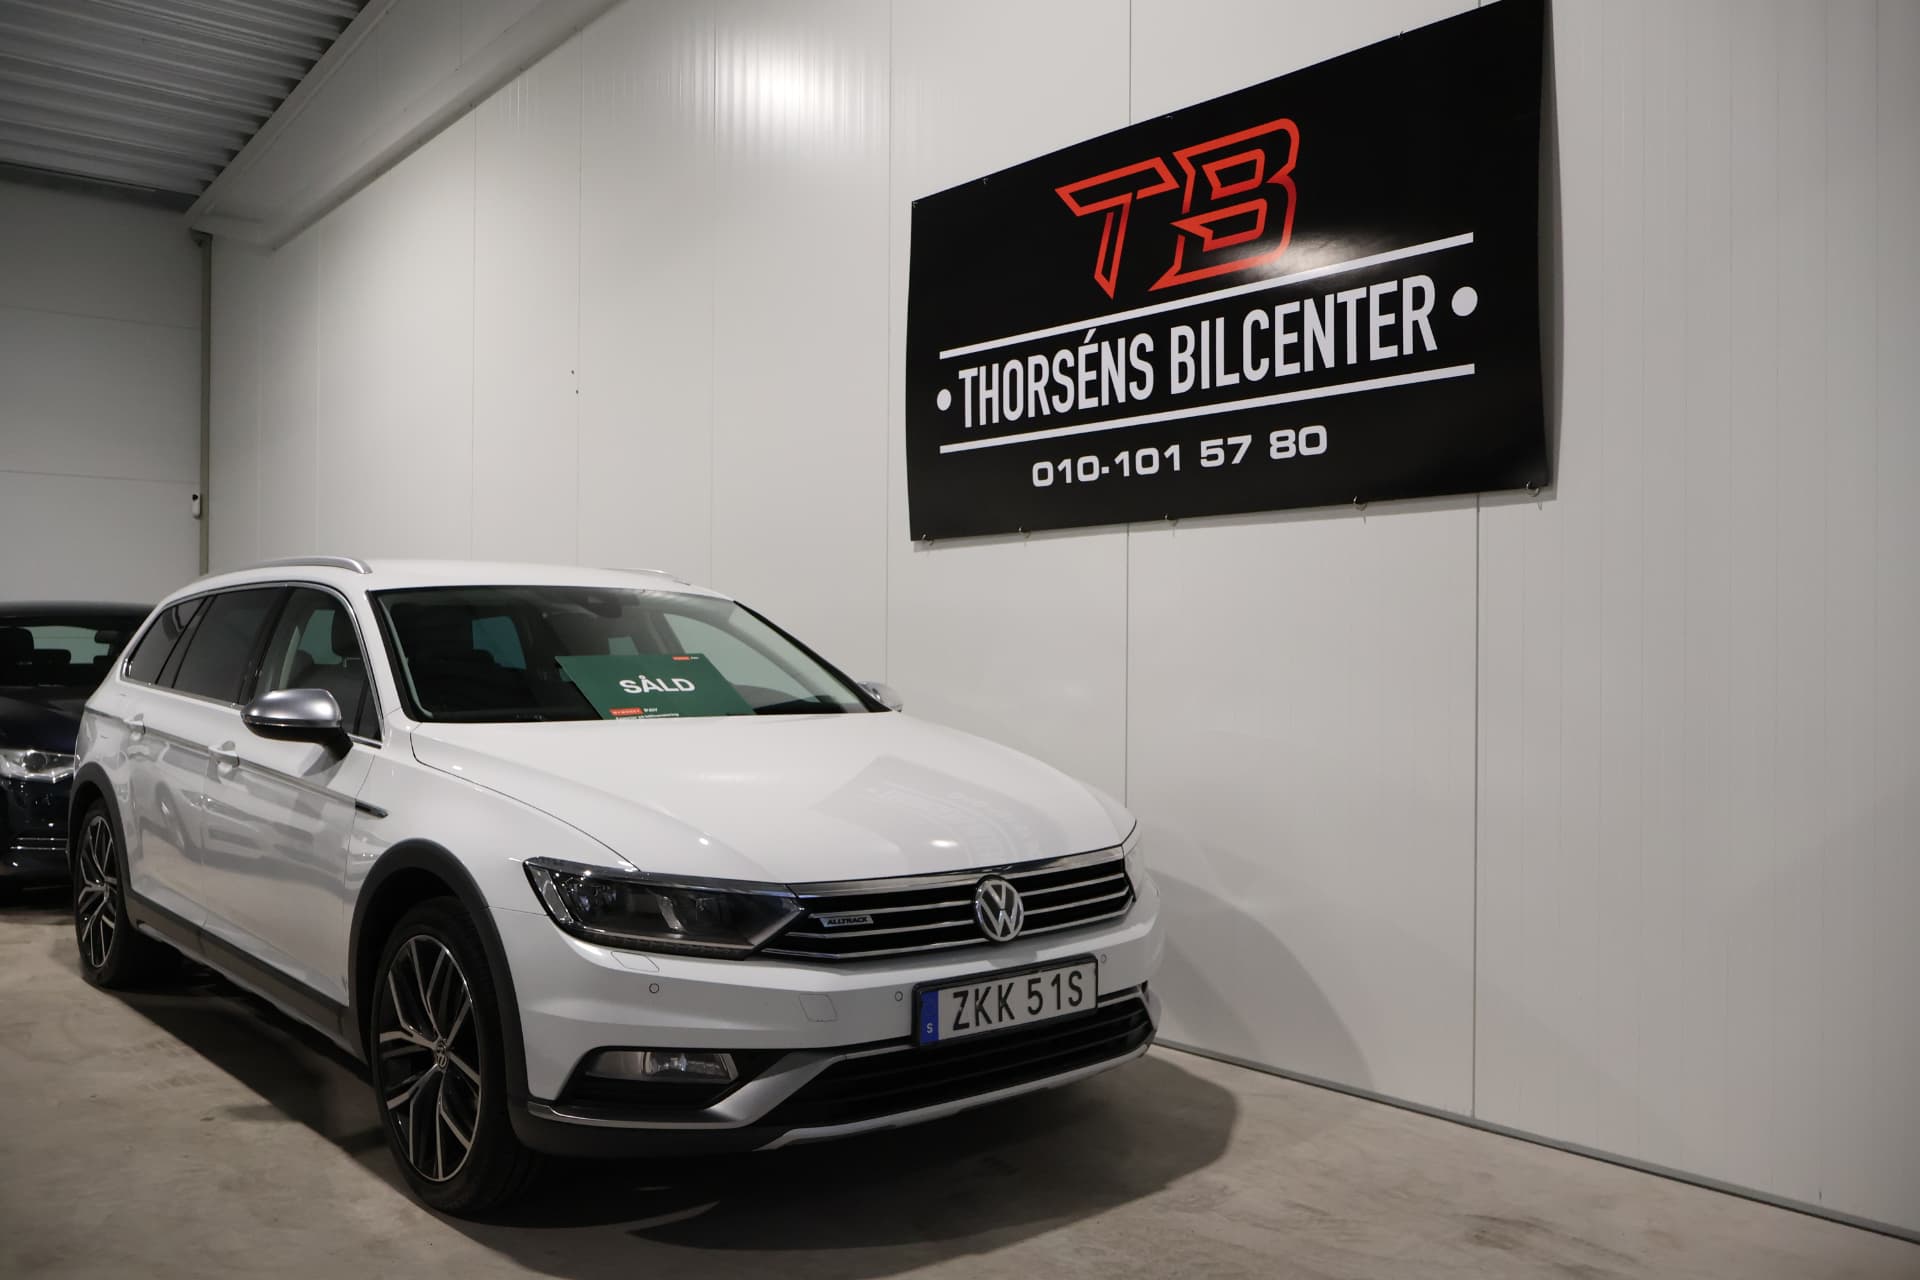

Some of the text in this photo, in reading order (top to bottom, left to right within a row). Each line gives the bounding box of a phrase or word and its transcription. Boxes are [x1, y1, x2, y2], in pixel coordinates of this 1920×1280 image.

[1055, 117, 1301, 300] TB
[958, 274, 1438, 428] THORSÉNS BILCENTER
[1032, 425, 1328, 487] 010-101 57 80
[618, 674, 696, 694] SÅLD
[826, 916, 870, 926] ALLTRACK
[926, 1022, 934, 1034] S
[952, 970, 1084, 1032] ZKK 51S
